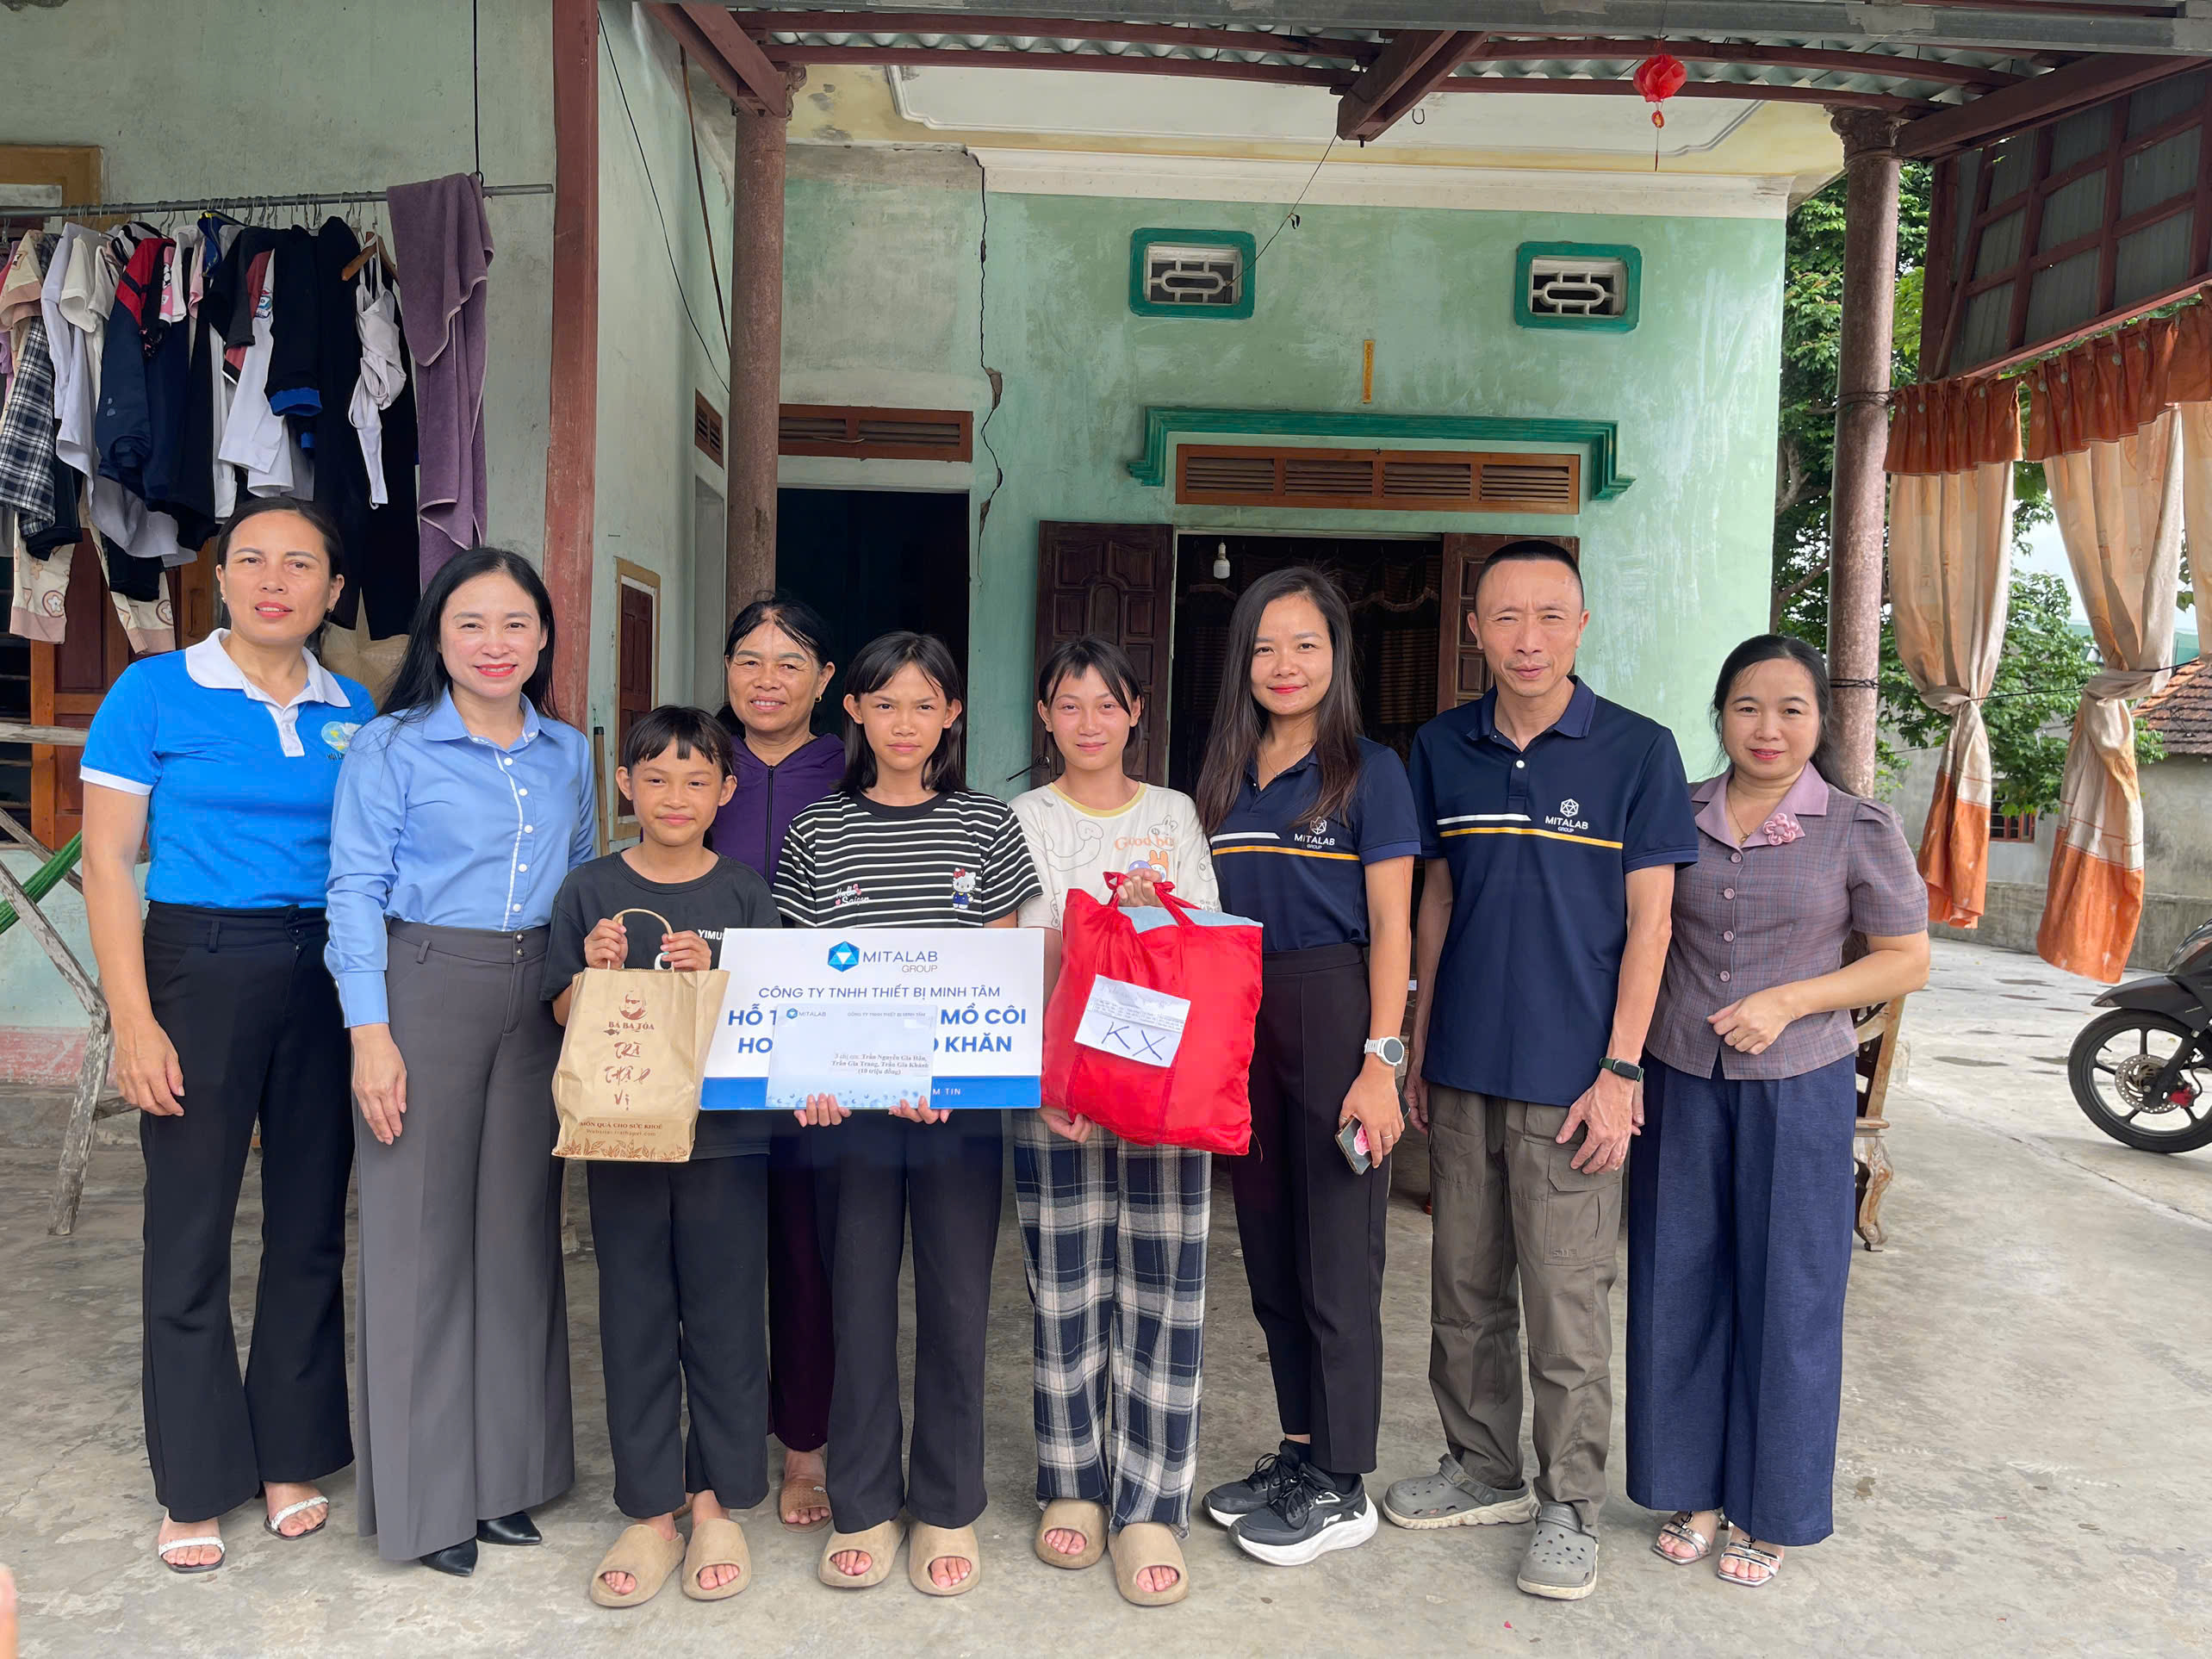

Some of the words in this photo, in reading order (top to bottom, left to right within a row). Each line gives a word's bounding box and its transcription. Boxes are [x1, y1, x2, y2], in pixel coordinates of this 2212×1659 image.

[1544, 815, 1589, 830] MITALAB
[1294, 833, 1335, 846] MITALAB
[698, 929, 724, 941] YIMU
[862, 950, 938, 963] MITALAB
[901, 964, 938, 973] GROUP
[758, 985, 804, 998] CÔNG
[808, 987, 824, 998] TY
[828, 987, 867, 998] TNHH
[872, 984, 910, 998] THIẾT
[913, 987, 926, 1000] BỊ
[929, 987, 967, 997] MINH
[972, 985, 1001, 997] TÂM
[728, 1003, 763, 1026] HỖ
[941, 1002, 979, 1025] MỒ
[985, 1004, 1026, 1025] CÔI
[738, 1037, 773, 1053] HO
[945, 1032, 1012, 1053] KHĂN
[945, 1087, 961, 1096] TIN
